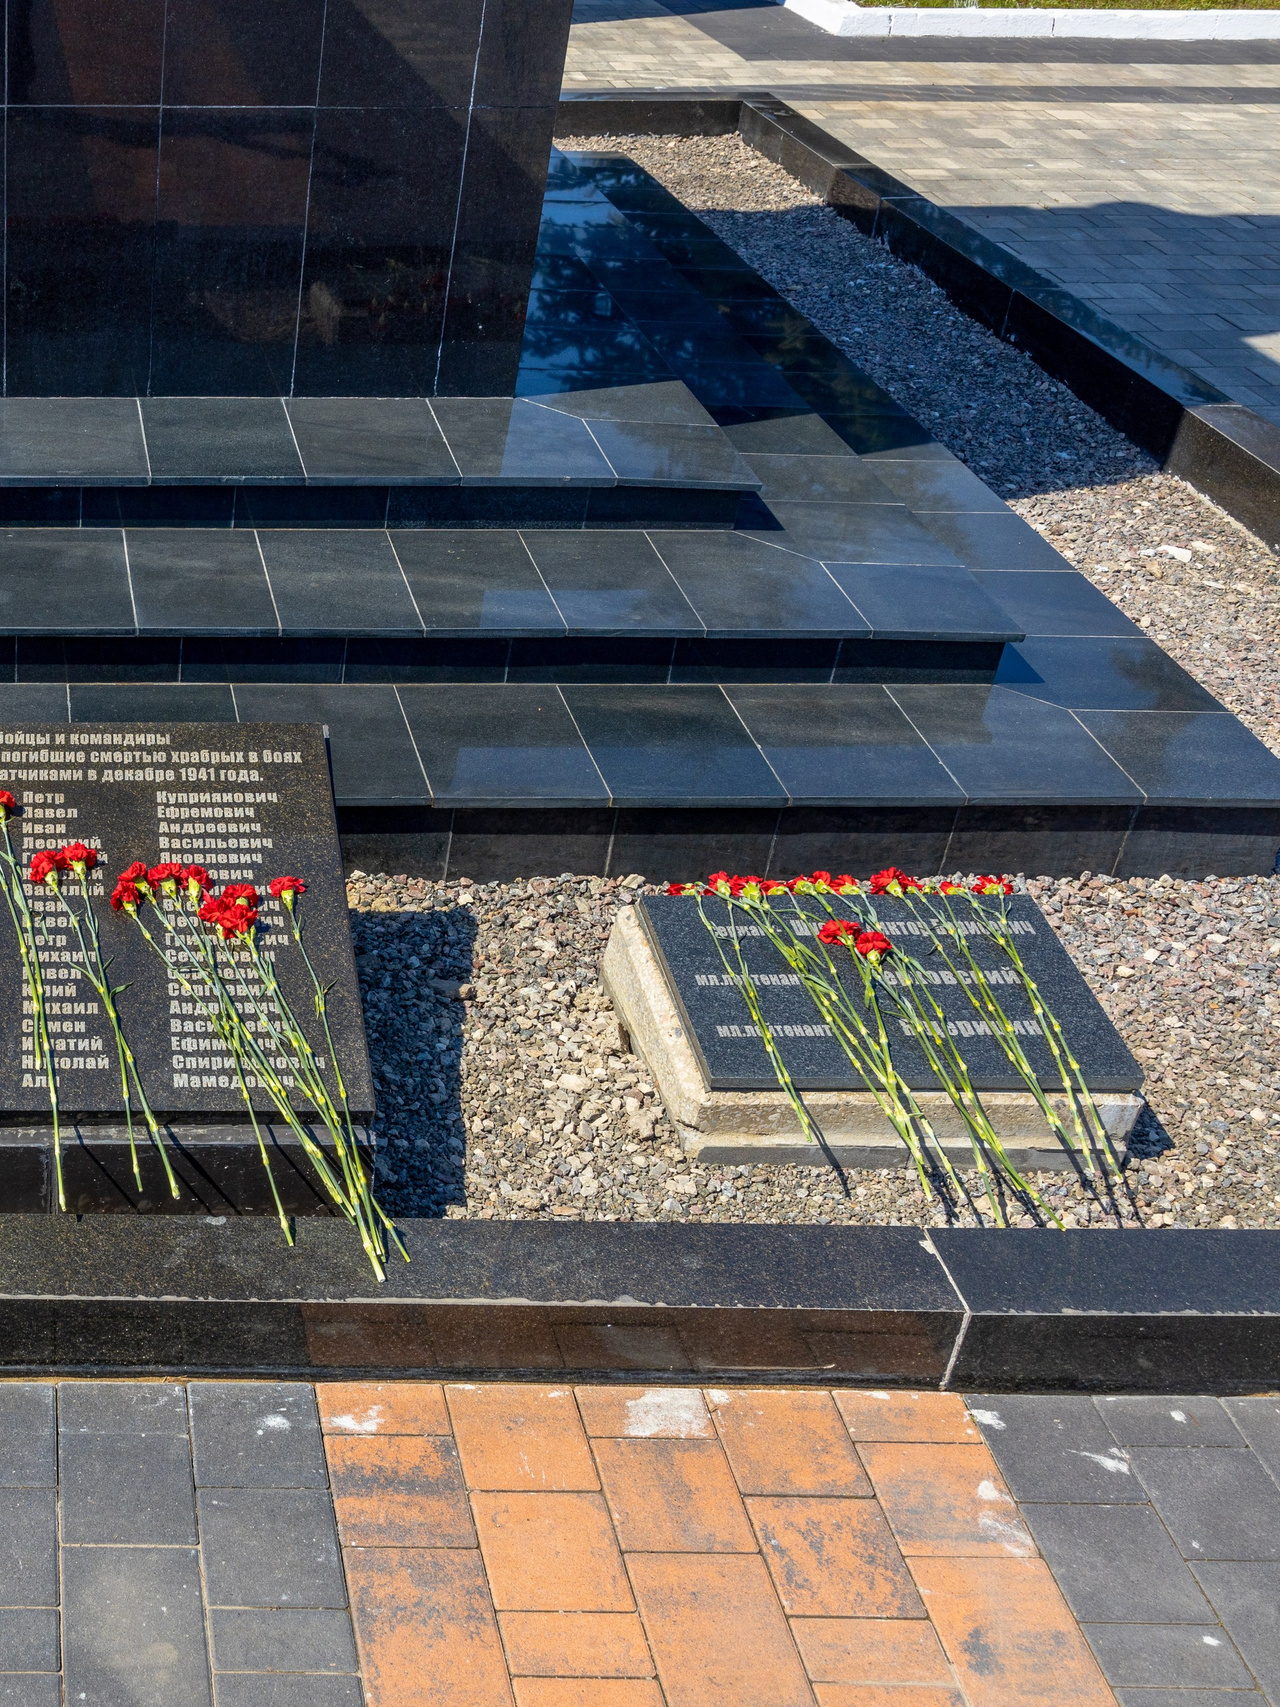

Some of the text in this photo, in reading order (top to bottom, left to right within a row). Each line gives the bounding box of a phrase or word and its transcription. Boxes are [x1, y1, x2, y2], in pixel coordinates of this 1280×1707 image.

[55, 733, 66, 745] и
[70, 733, 171, 746] командиры
[1, 749, 86, 763] погибшие
[90, 751, 167, 764] смертью
[170, 750, 245, 764] храбрых
[248, 751, 257, 763] в
[263, 749, 303, 763] боях
[88, 769, 97, 781] в
[101, 768, 175, 783] декабре
[179, 768, 216, 781] 1941
[220, 769, 264, 783] года.
[22, 791, 66, 804] Петр
[156, 790, 279, 804] Куприянович
[157, 805, 255, 819] Ефремович
[22, 821, 261, 834] Иван Андреевич
[159, 836, 273, 849] Васильевич
[160, 851, 263, 864] Яковлевич
[169, 999, 280, 1015] Андревич
[22, 1019, 86, 1033] Смен
[22, 1035, 103, 1051] Иатий
